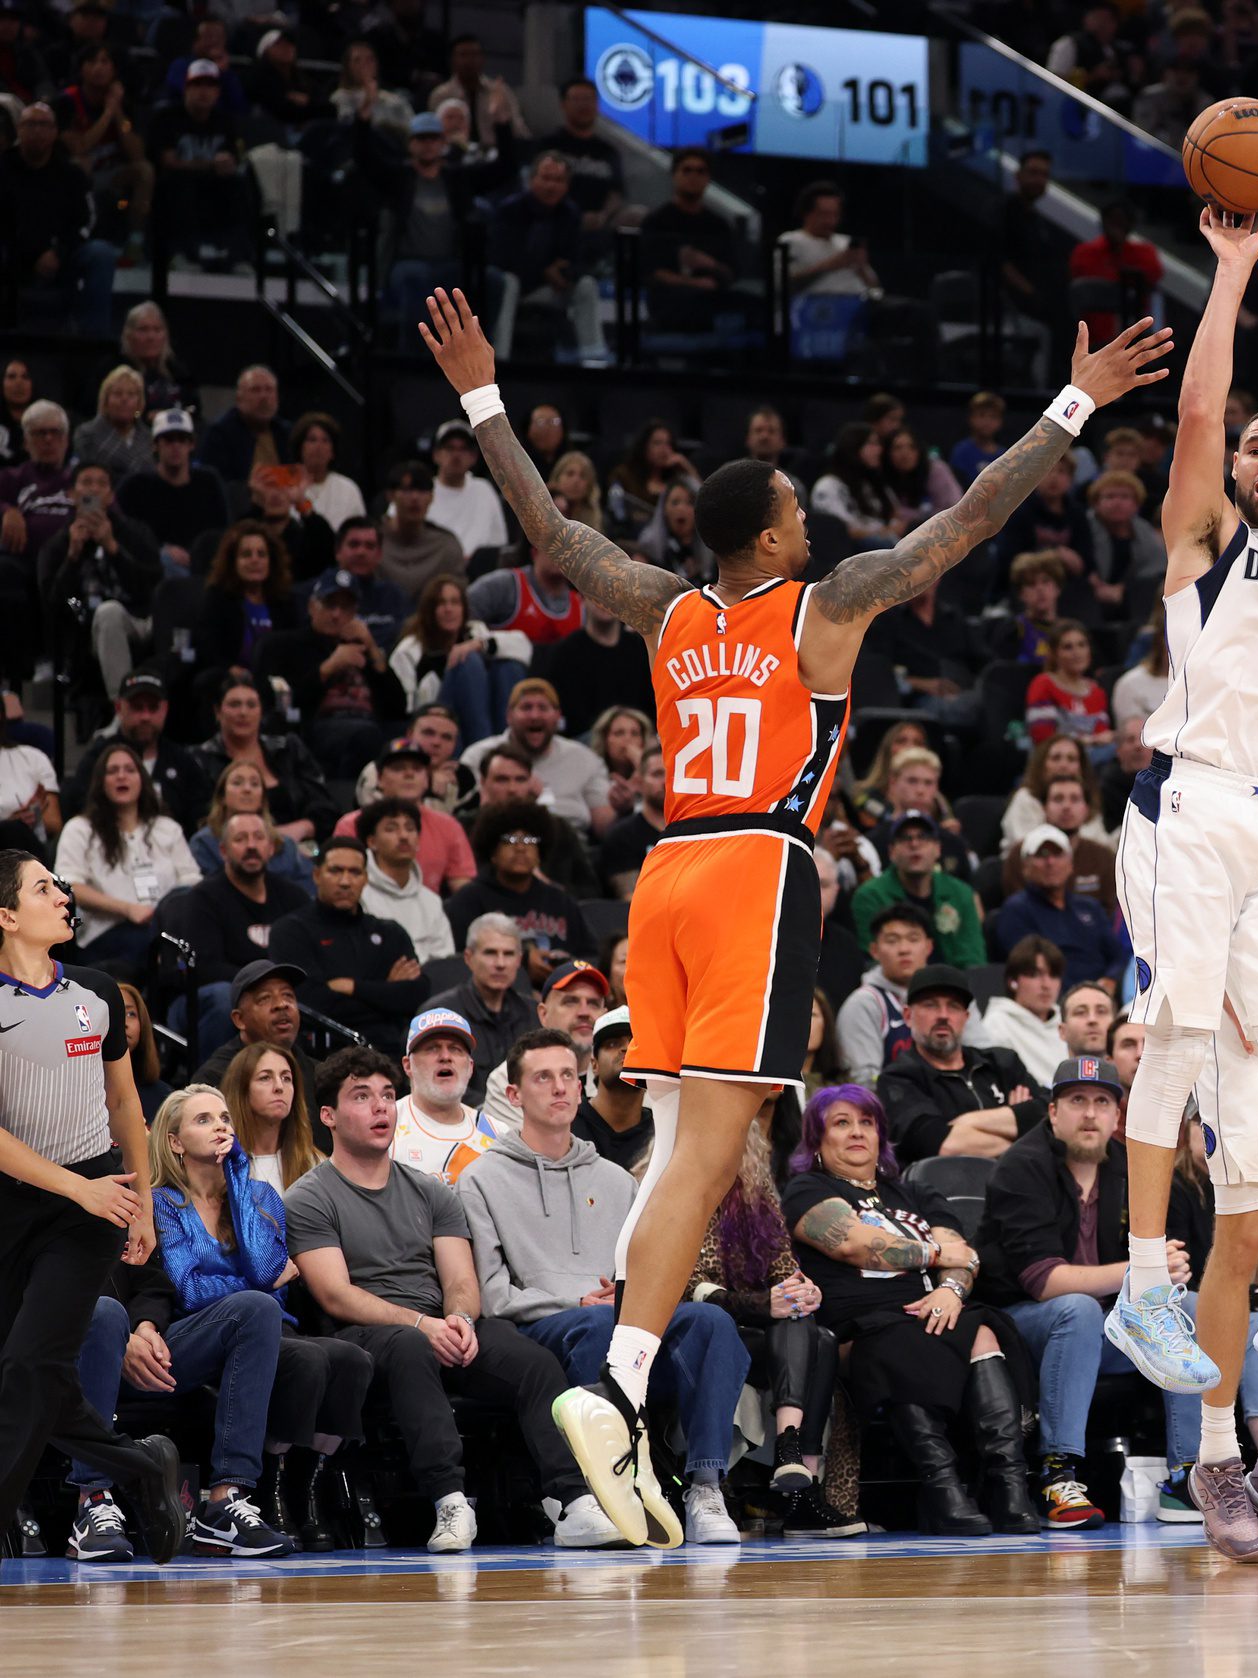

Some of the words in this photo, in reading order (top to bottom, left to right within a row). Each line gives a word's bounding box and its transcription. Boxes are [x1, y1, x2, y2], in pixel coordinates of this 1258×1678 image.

[656, 58, 750, 117] 103
[842, 77, 918, 129] 101
[666, 642, 780, 691] COLLINS
[672, 696, 762, 798] 20
[67, 1040, 102, 1053] Emirates
